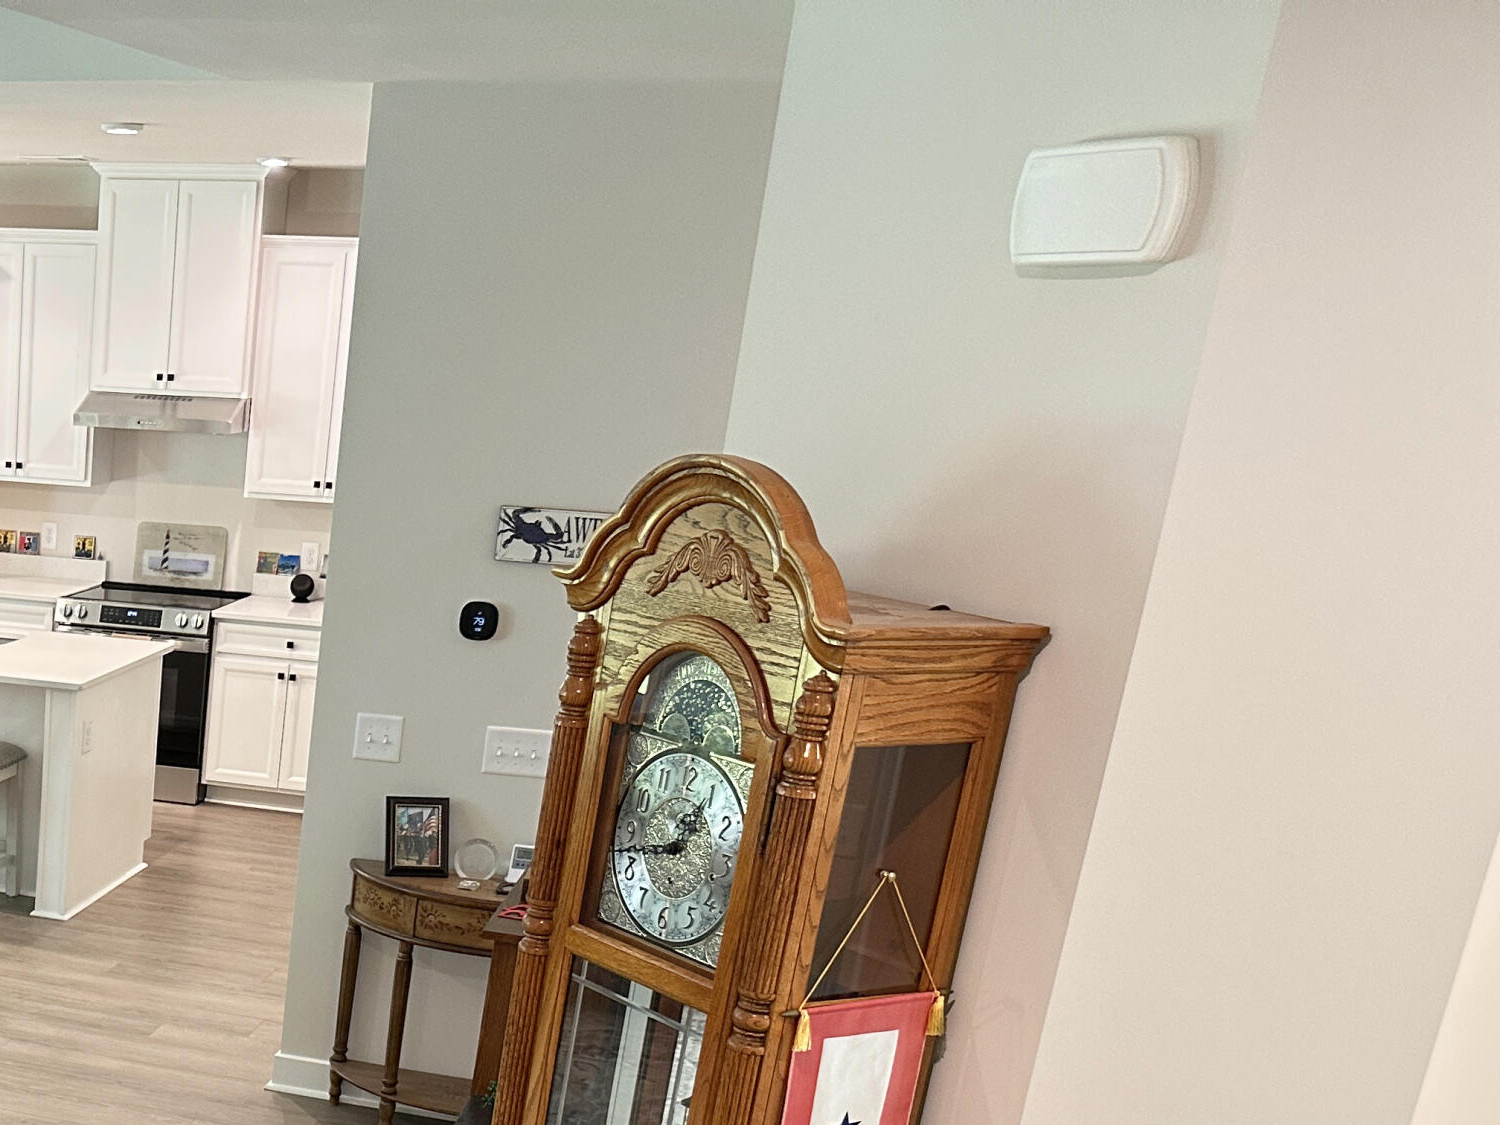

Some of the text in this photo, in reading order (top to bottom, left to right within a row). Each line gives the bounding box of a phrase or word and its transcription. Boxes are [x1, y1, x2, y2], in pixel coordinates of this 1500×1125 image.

[472, 616, 485, 626] 79
[658, 767, 671, 793] 11
[681, 766, 699, 792] 12
[636, 787, 650, 813] 10
[707, 784, 716, 809] 1
[626, 820, 636, 843] 9
[718, 816, 732, 841] 2
[624, 855, 637, 881] 8
[711, 853, 733, 878] 3
[639, 886, 649, 910] 7
[703, 884, 717, 912] 4
[657, 906, 669, 930] 6
[683, 905, 699, 929] 5
